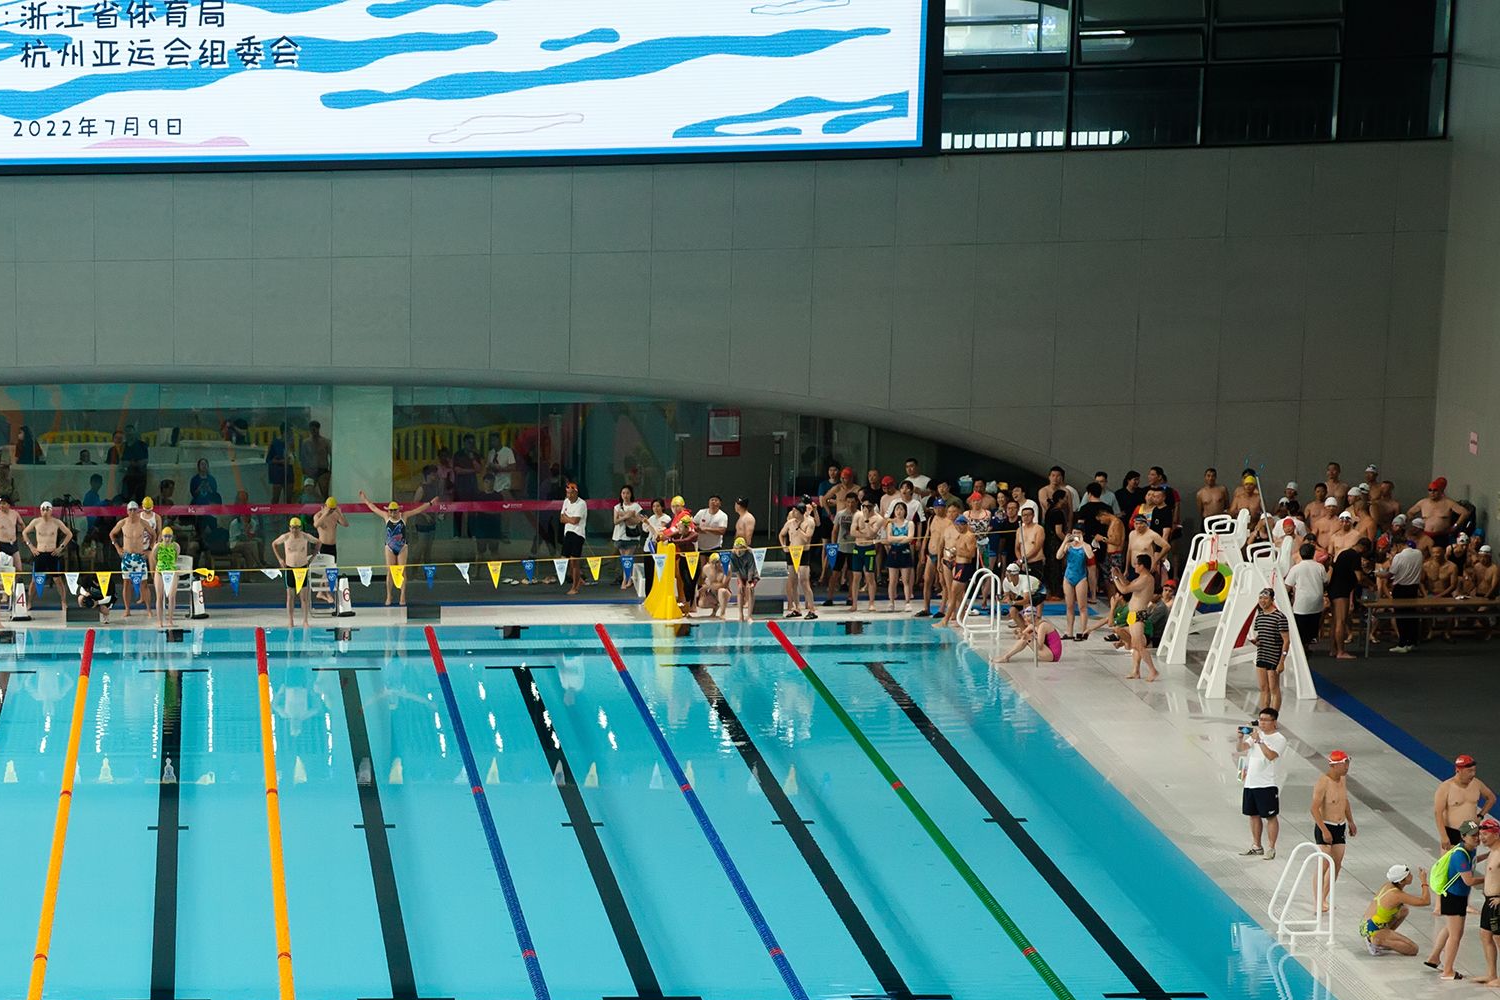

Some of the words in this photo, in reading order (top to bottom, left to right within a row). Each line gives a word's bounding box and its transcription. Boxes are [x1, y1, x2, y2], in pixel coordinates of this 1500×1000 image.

[20, 36, 300, 69] 杭州亚运会组委会
[13, 116, 183, 138] 2022年7月9日
[16, 593, 26, 607] 4
[343, 588, 351, 602] 6
